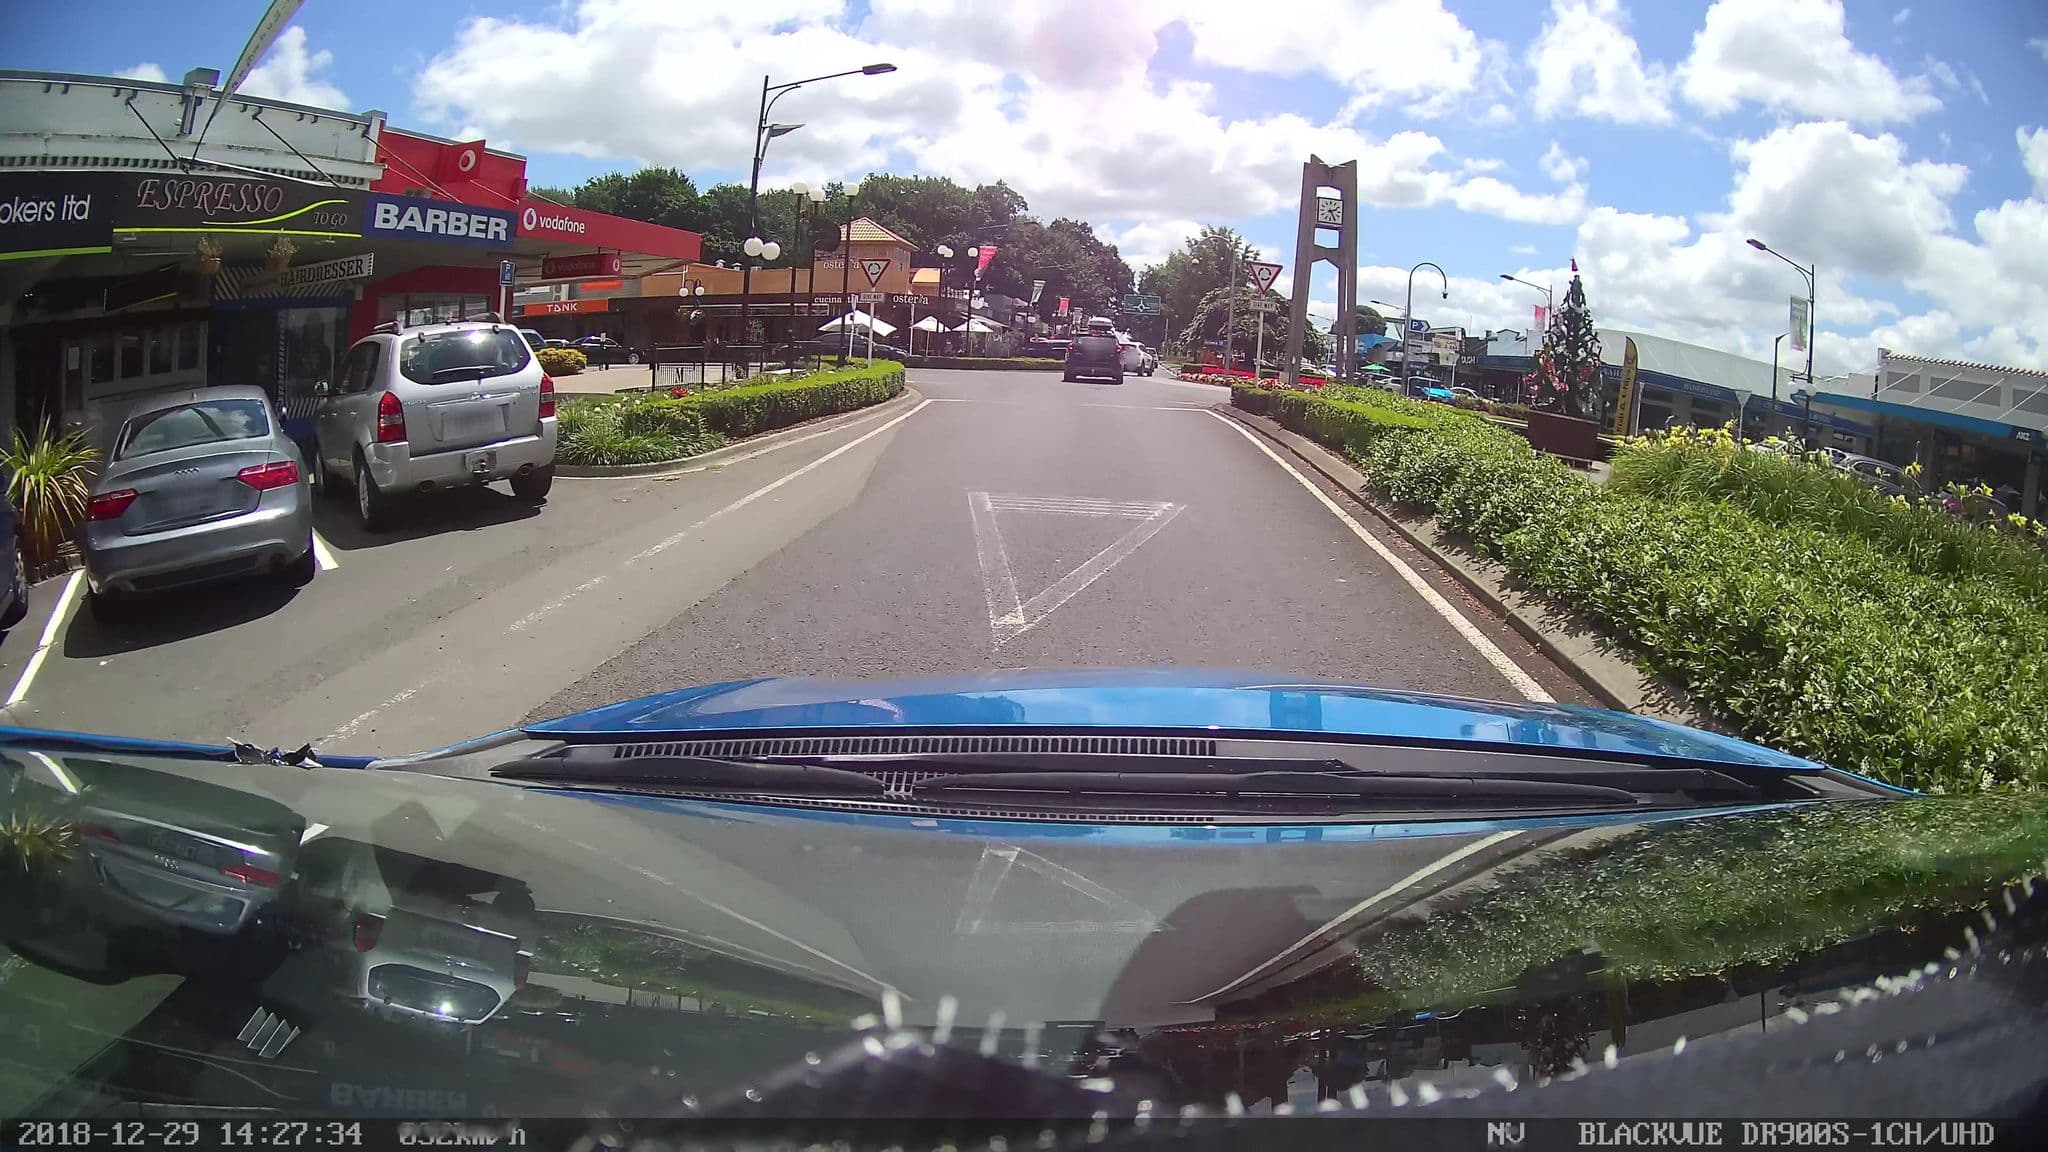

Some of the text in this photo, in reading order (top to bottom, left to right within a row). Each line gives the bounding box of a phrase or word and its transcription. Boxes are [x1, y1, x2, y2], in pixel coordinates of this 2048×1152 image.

[0, 194, 91, 224] okers ltd
[137, 179, 283, 215] ESPRESSO
[313, 212, 347, 226] TO GO
[374, 203, 508, 241] BARBER
[539, 215, 585, 234] vodafone
[281, 258, 364, 287] HAIRDRESSER
[546, 302, 578, 313] TANK
[814, 294, 842, 303] cucina
